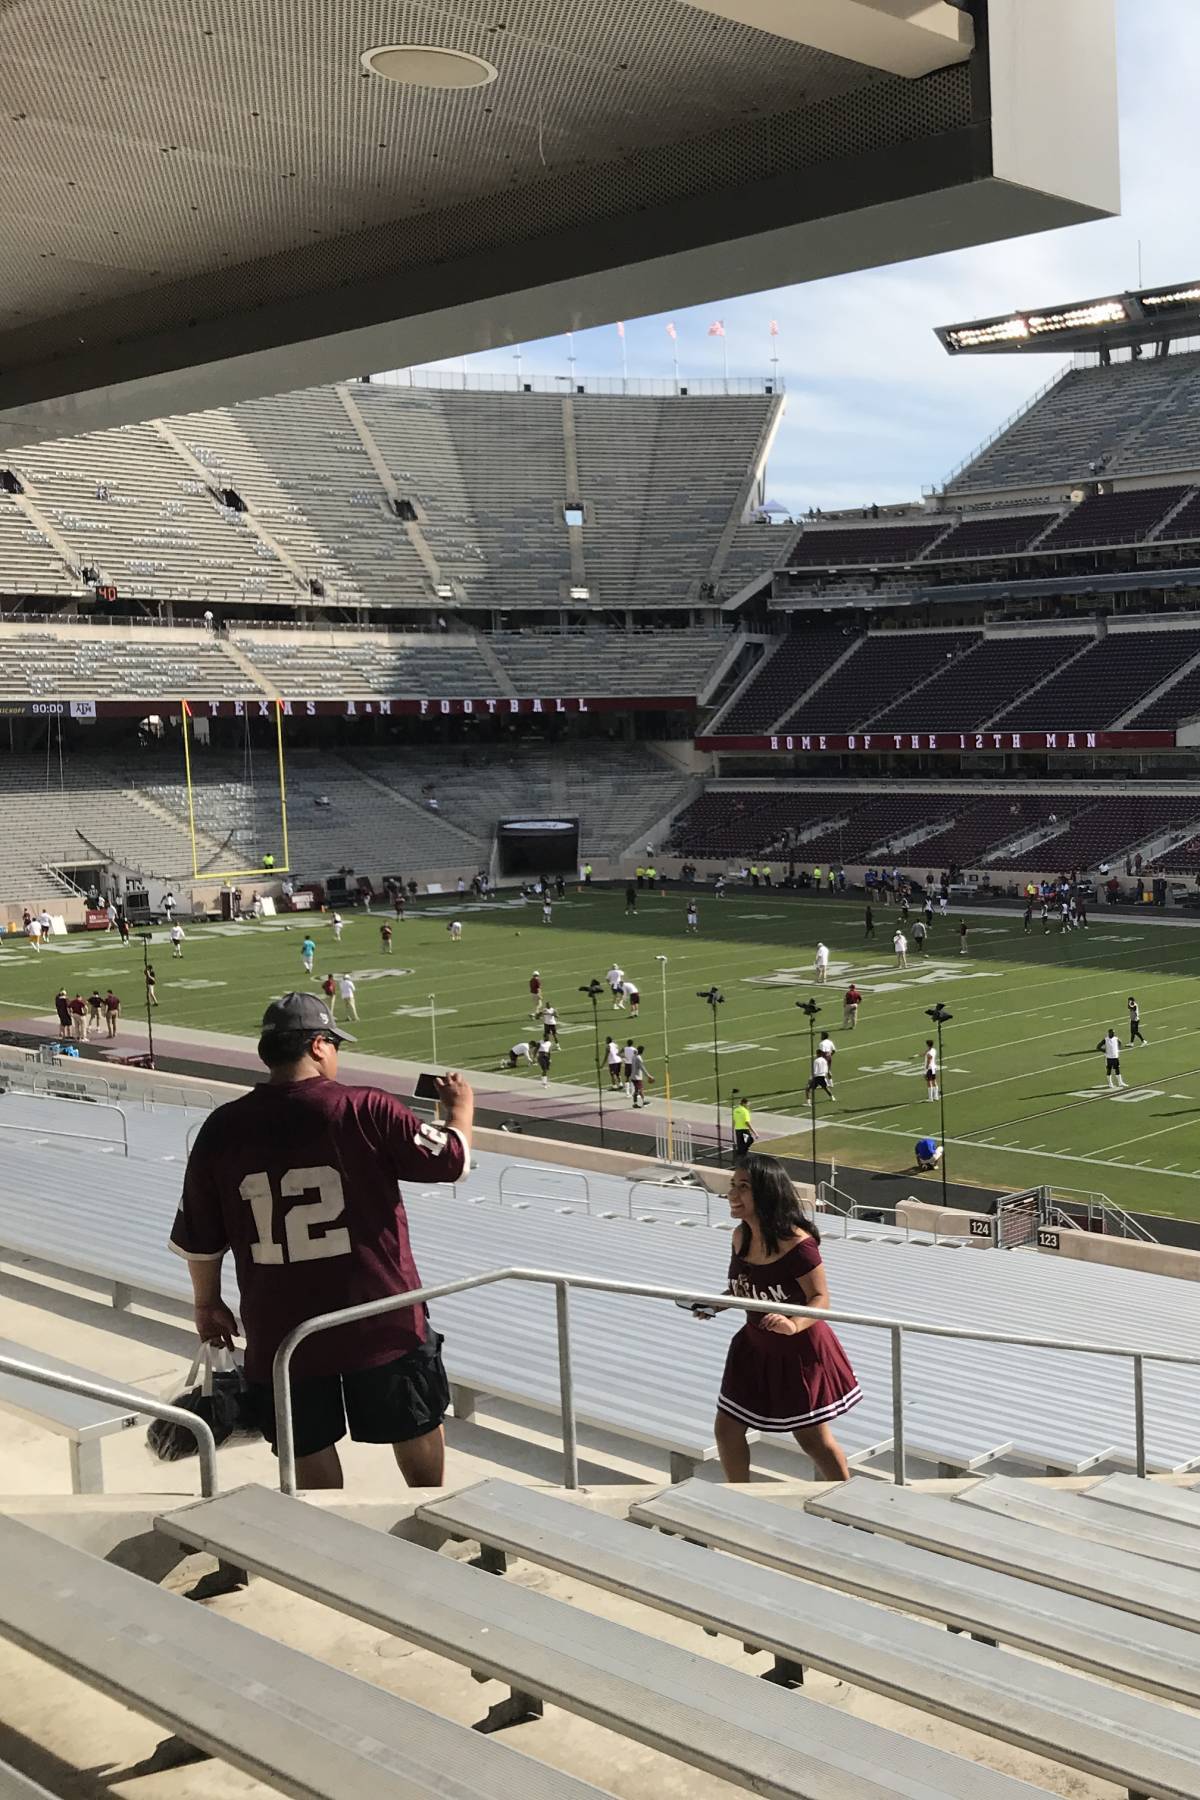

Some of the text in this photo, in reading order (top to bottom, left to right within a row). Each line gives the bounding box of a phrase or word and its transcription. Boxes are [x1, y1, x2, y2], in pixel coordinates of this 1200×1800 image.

[32, 703, 64, 713] 90:00
[209, 701, 316, 716] TEXAS
[420, 699, 588, 714] FOOTBALL
[771, 733, 1096, 750] HOME OF THE 12TH MAN
[1065, 1084, 1166, 1103] 20
[413, 1123, 448, 1156] 12
[238, 1165, 352, 1265] 12
[971, 1221, 990, 1235] 124
[1039, 1232, 1057, 1247] 123
